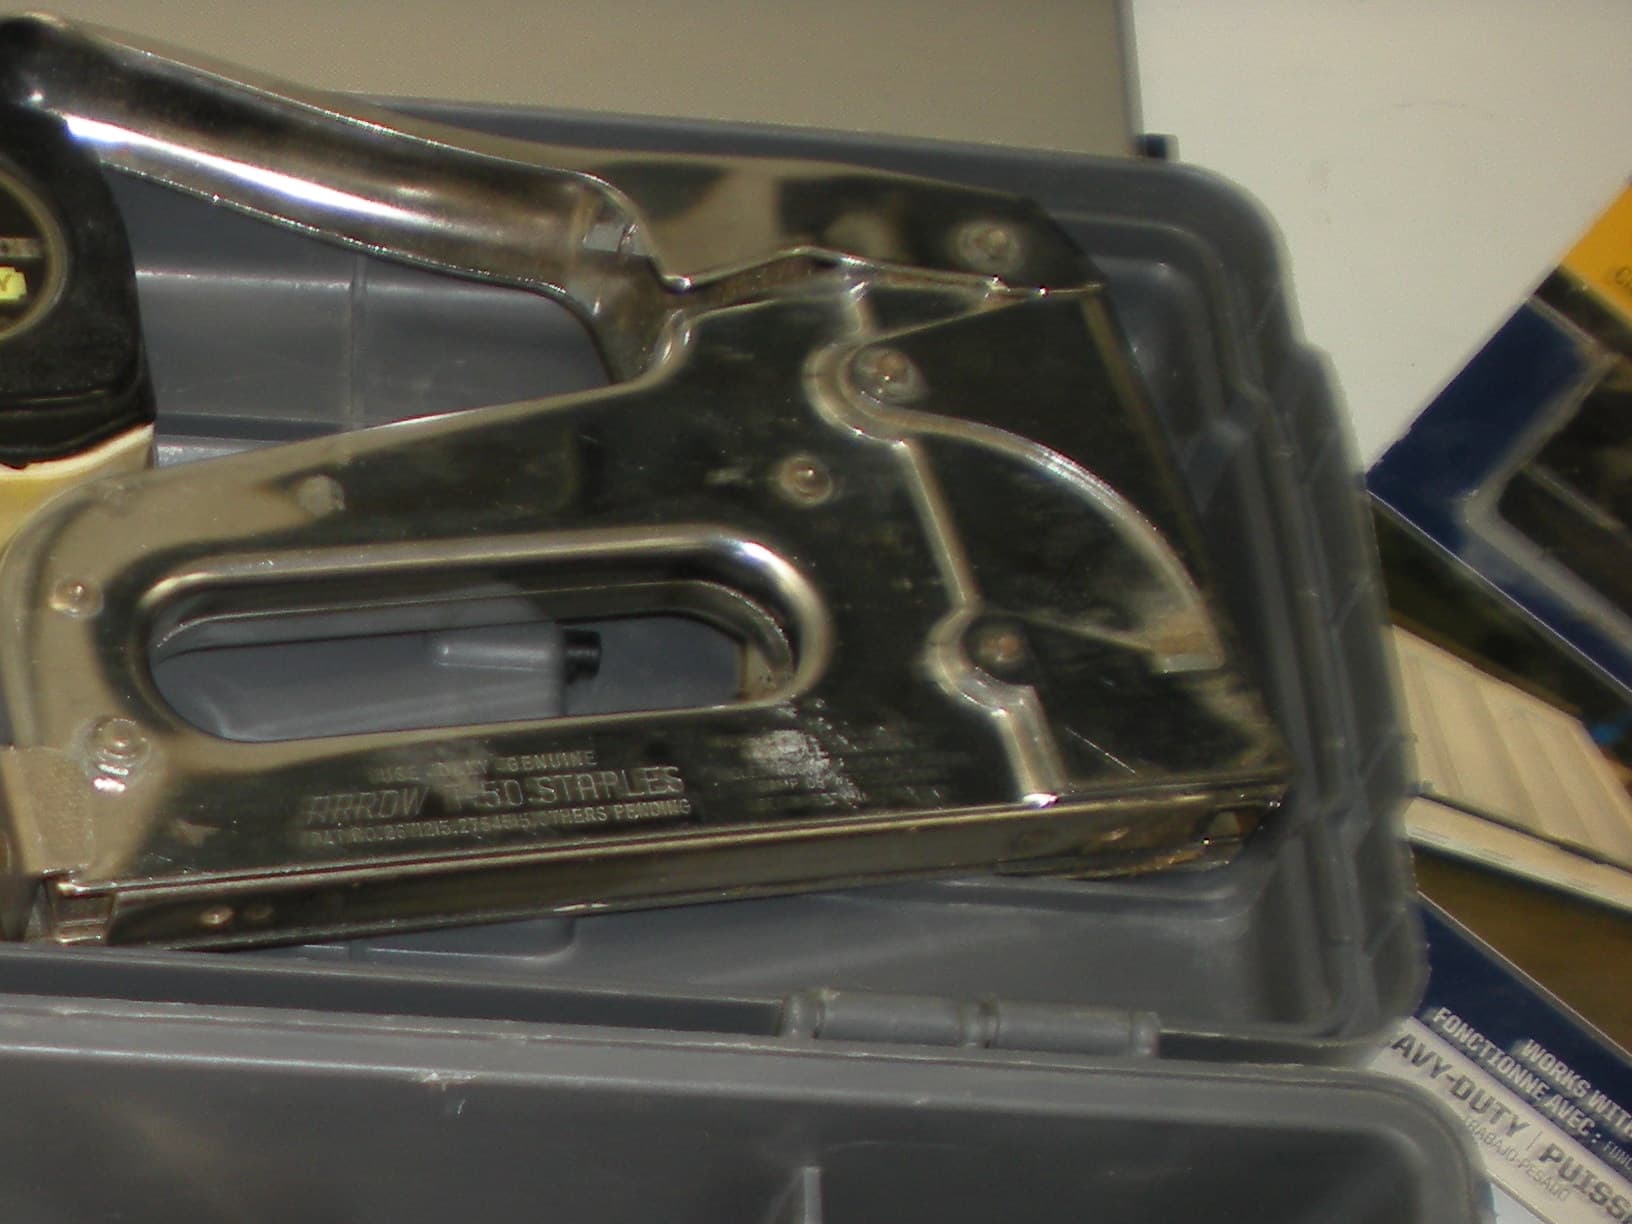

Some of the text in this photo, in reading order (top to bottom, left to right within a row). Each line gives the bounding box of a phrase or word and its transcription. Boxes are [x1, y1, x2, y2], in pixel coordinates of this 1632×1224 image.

[507, 750, 599, 772] GENUINE
[307, 784, 428, 825] ARROW
[533, 766, 685, 805] STAPLES
[1432, 1006, 1551, 1101] FONCTIONNE
[1521, 1038, 1593, 1099] WORKS
